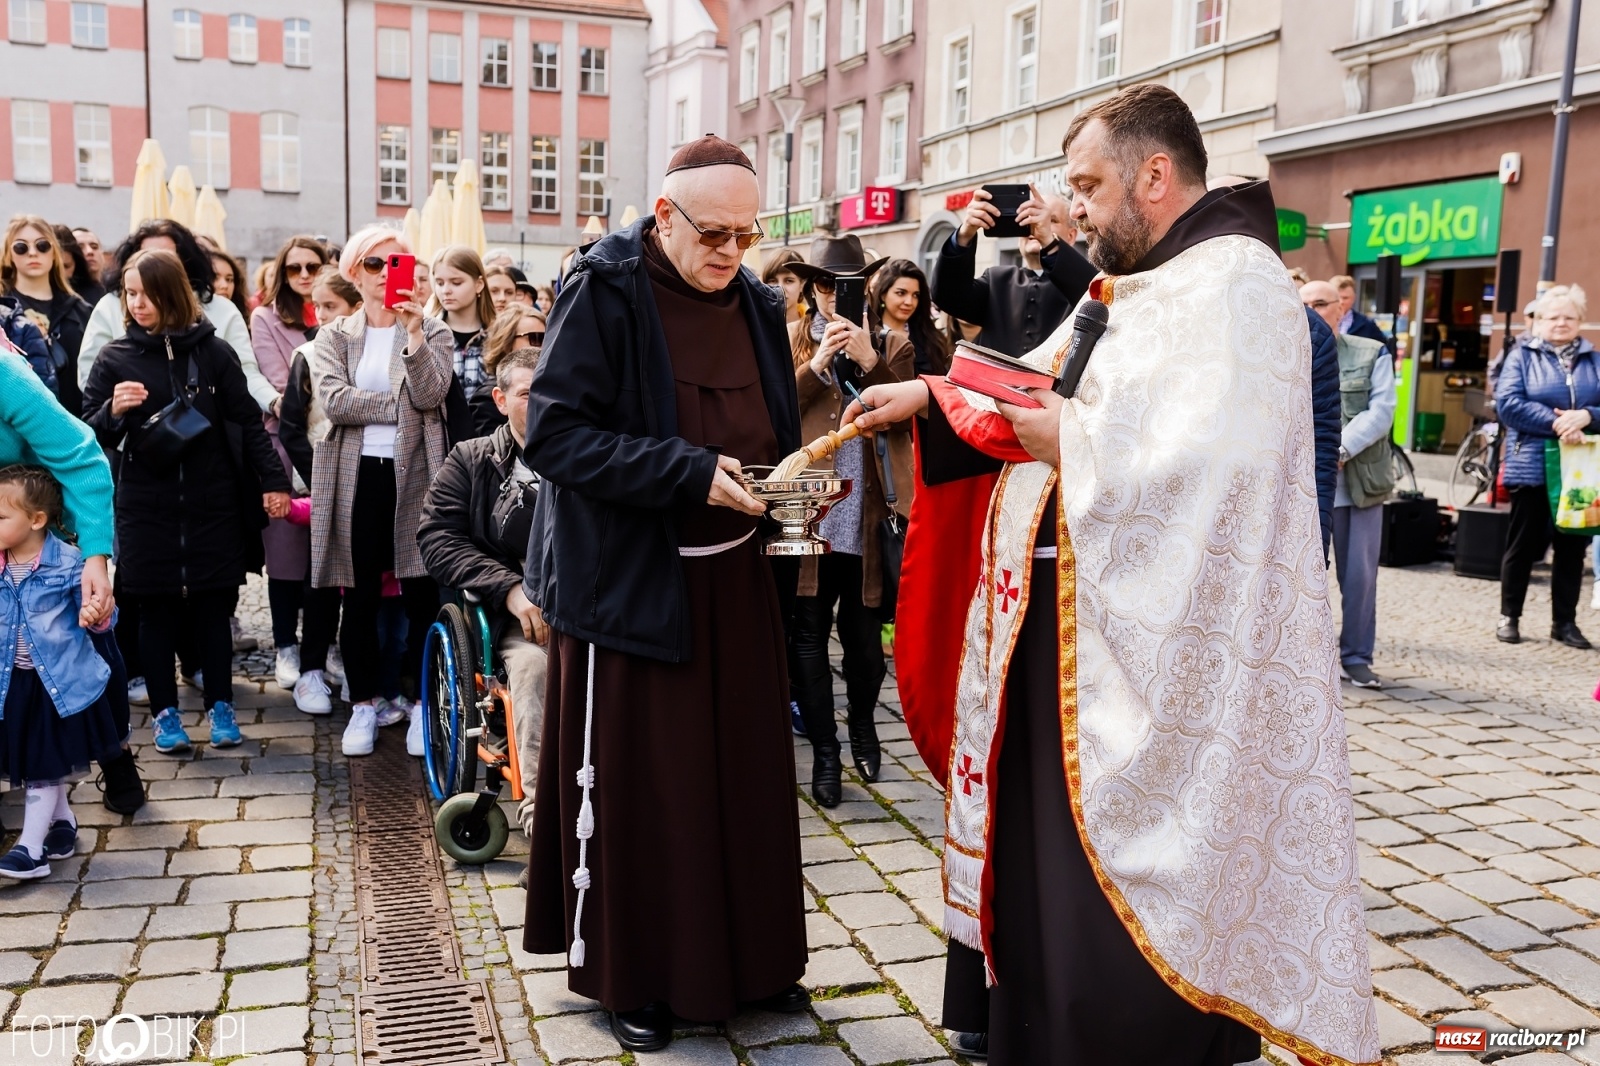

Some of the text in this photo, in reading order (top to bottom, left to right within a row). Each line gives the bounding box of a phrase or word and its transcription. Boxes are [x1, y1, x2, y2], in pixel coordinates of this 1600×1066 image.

[871, 191, 890, 215] T
[1278, 218, 1300, 237] ka
[1366, 199, 1478, 247] żabka
